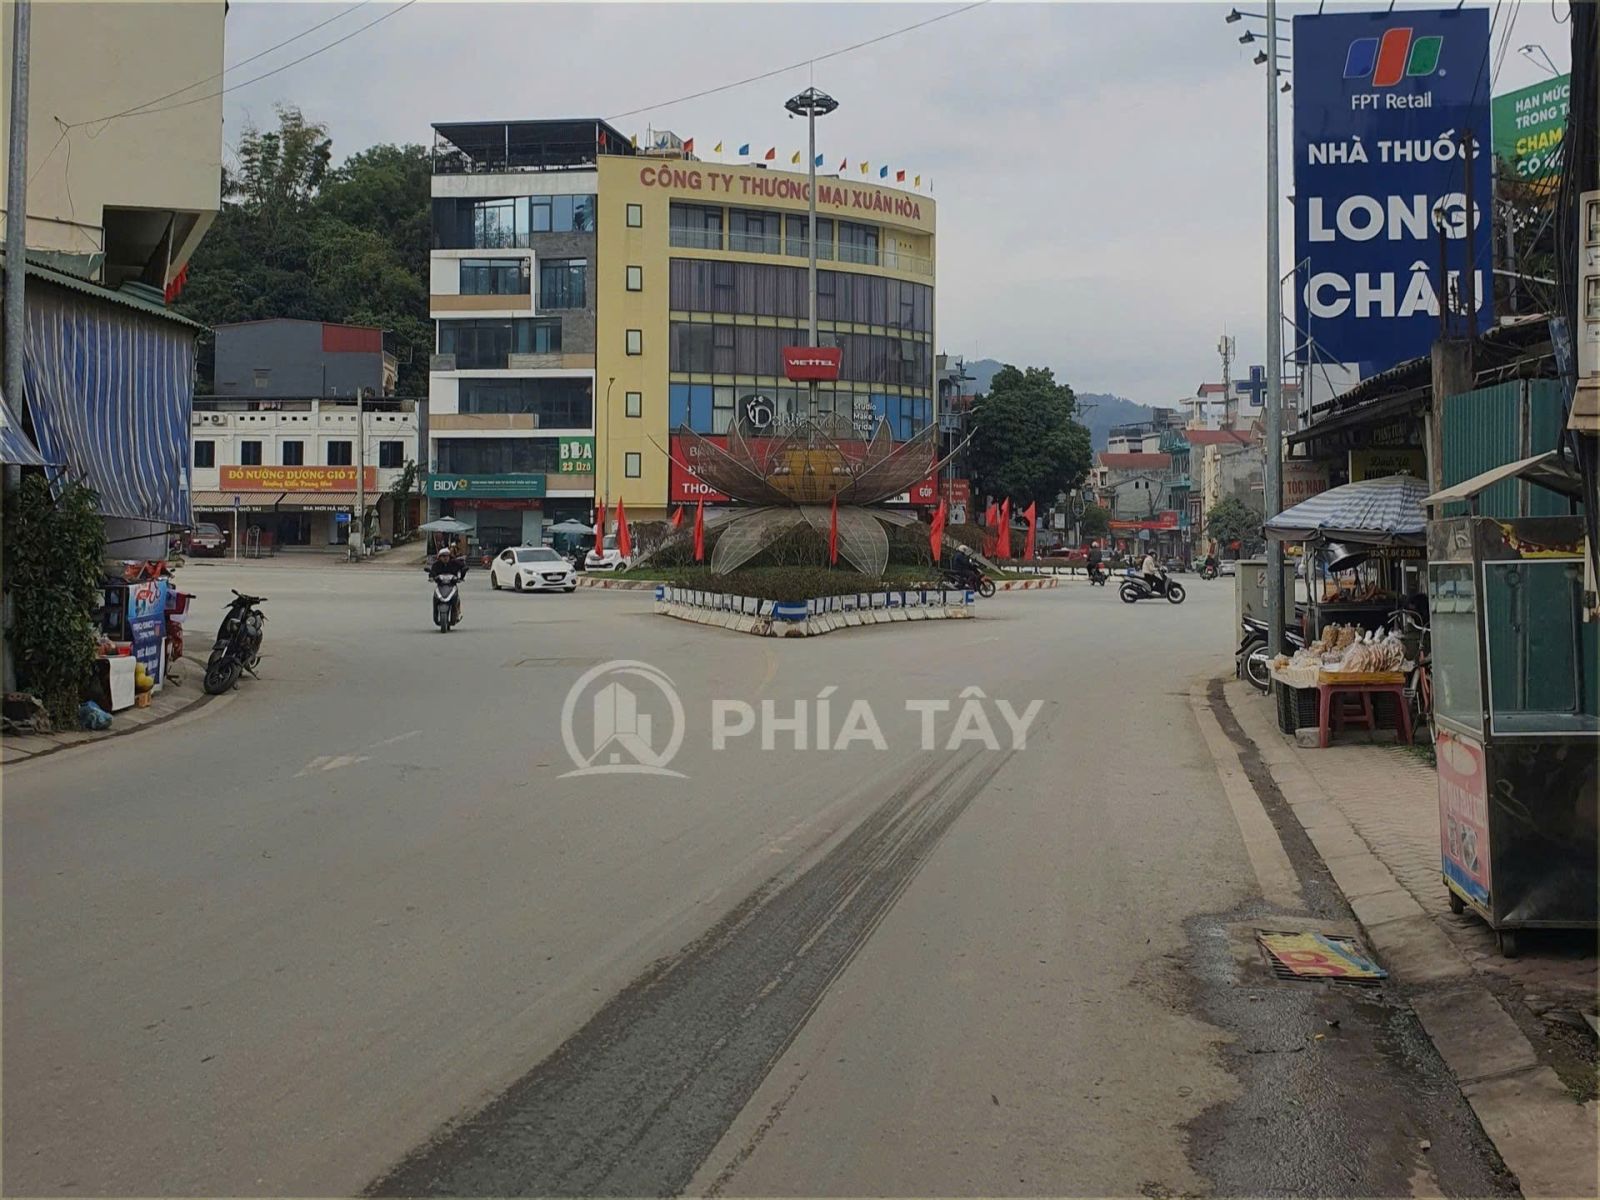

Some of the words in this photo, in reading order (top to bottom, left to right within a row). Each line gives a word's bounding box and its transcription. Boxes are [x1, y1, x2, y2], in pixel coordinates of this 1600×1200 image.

[1351, 94, 1380, 110] FPT
[1386, 91, 1432, 109] Retail
[1515, 94, 1540, 113] HẠN
[1543, 84, 1571, 104] MỨC
[1515, 106, 1558, 130] TRONG
[1308, 135, 1369, 165] NHÀ
[1516, 127, 1563, 155] CHẠM
[640, 164, 701, 190] CÔNG
[707, 172, 734, 192] TY
[740, 176, 811, 201] THƯƠNG
[818, 185, 848, 209] MẠI
[852, 190, 893, 215] XUÂN
[895, 196, 921, 221] HÒA
[1308, 192, 1481, 242] LONG
[1303, 260, 1483, 318] CHÂU
[433, 480, 459, 491] BIDV
